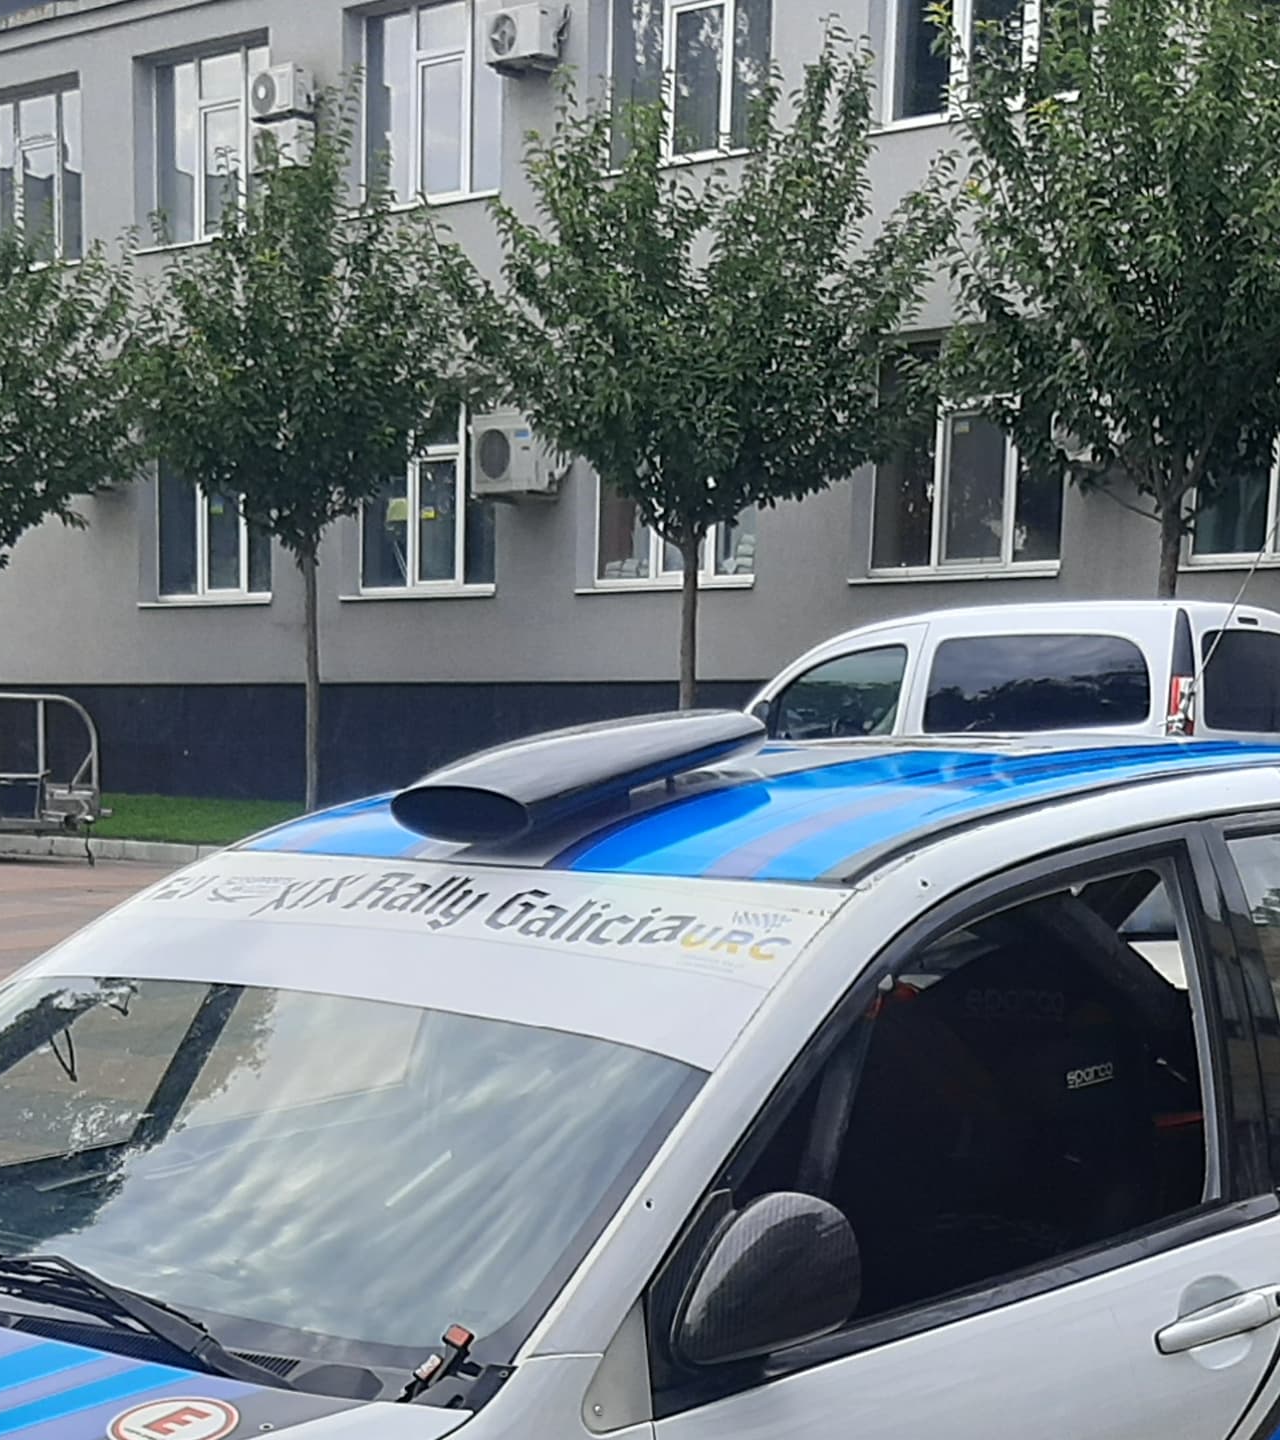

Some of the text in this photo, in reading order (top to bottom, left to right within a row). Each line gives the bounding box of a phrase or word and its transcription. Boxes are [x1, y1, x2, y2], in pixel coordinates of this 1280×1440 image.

[341, 872, 490, 930] Rally
[484, 889, 697, 945] Galicia
[680, 924, 792, 961] URC
[1066, 1062, 1114, 1089] sparco
[142, 1406, 212, 1436] E
